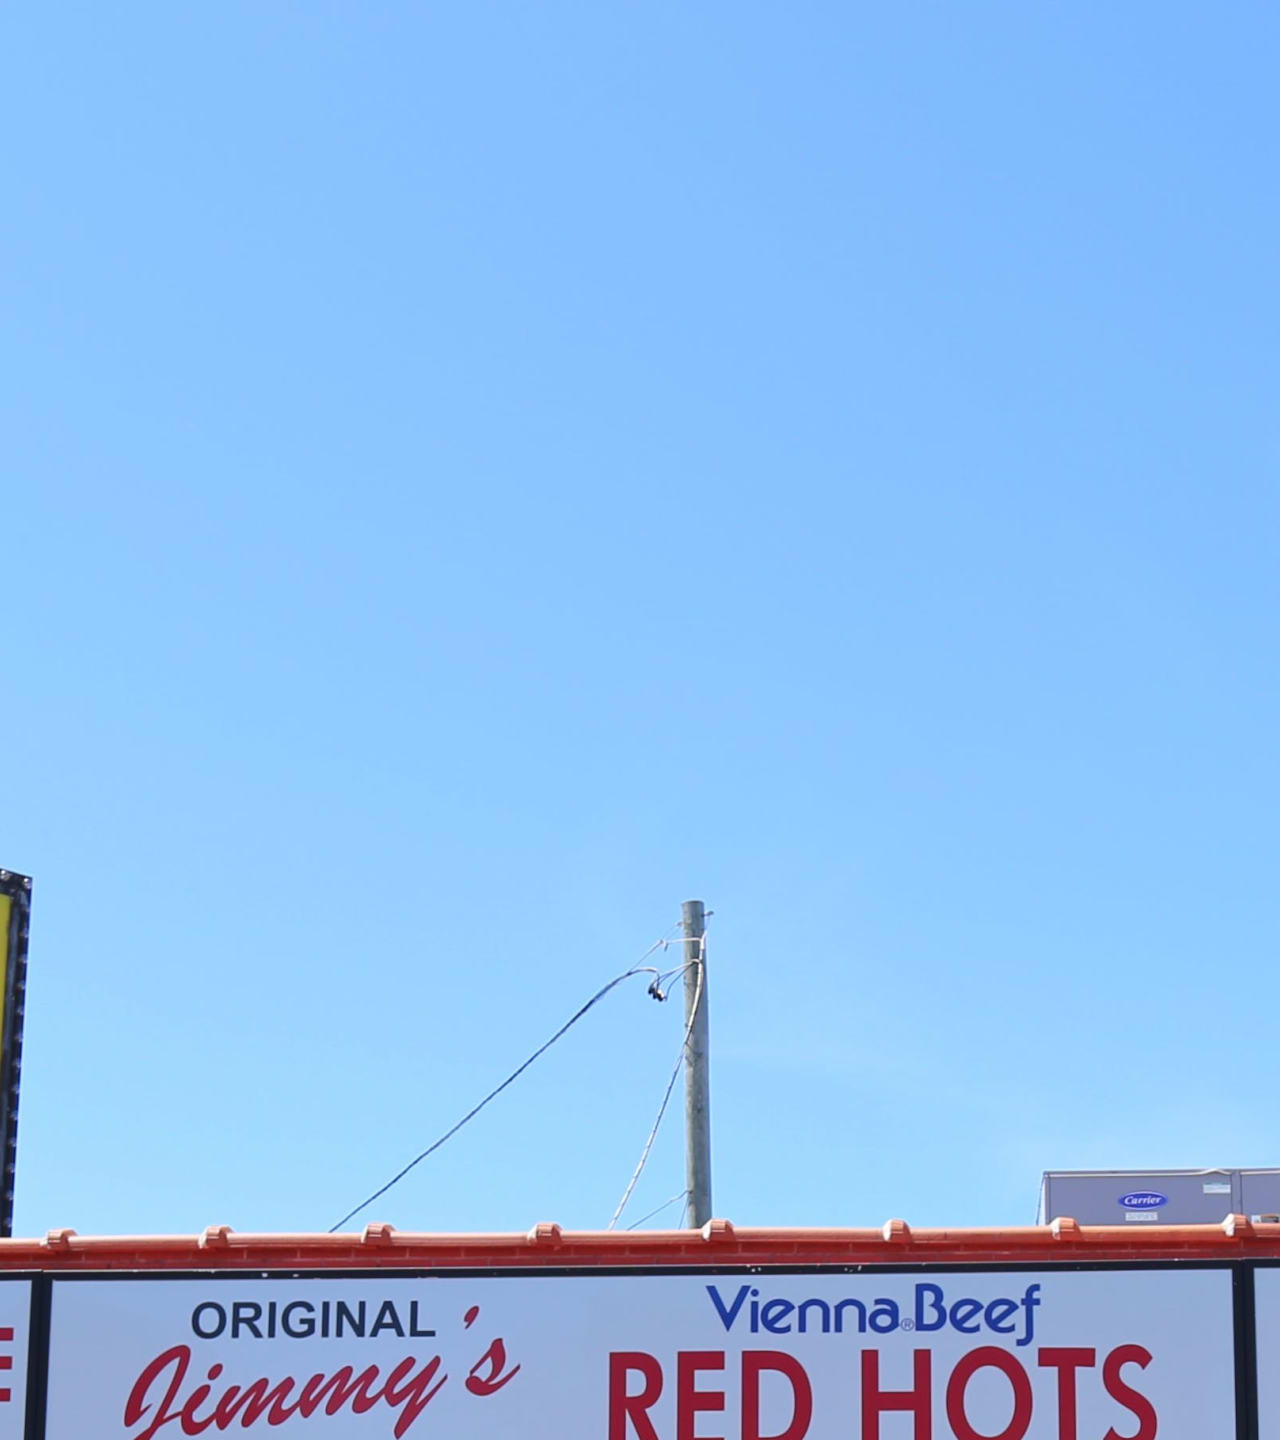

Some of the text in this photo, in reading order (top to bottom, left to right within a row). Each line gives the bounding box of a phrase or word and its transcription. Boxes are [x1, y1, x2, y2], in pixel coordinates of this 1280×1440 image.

[1124, 1195, 1162, 1205] Carrier
[190, 1300, 437, 1340] ORIGINAL
[705, 1283, 1042, 1347] Vienna Beef
